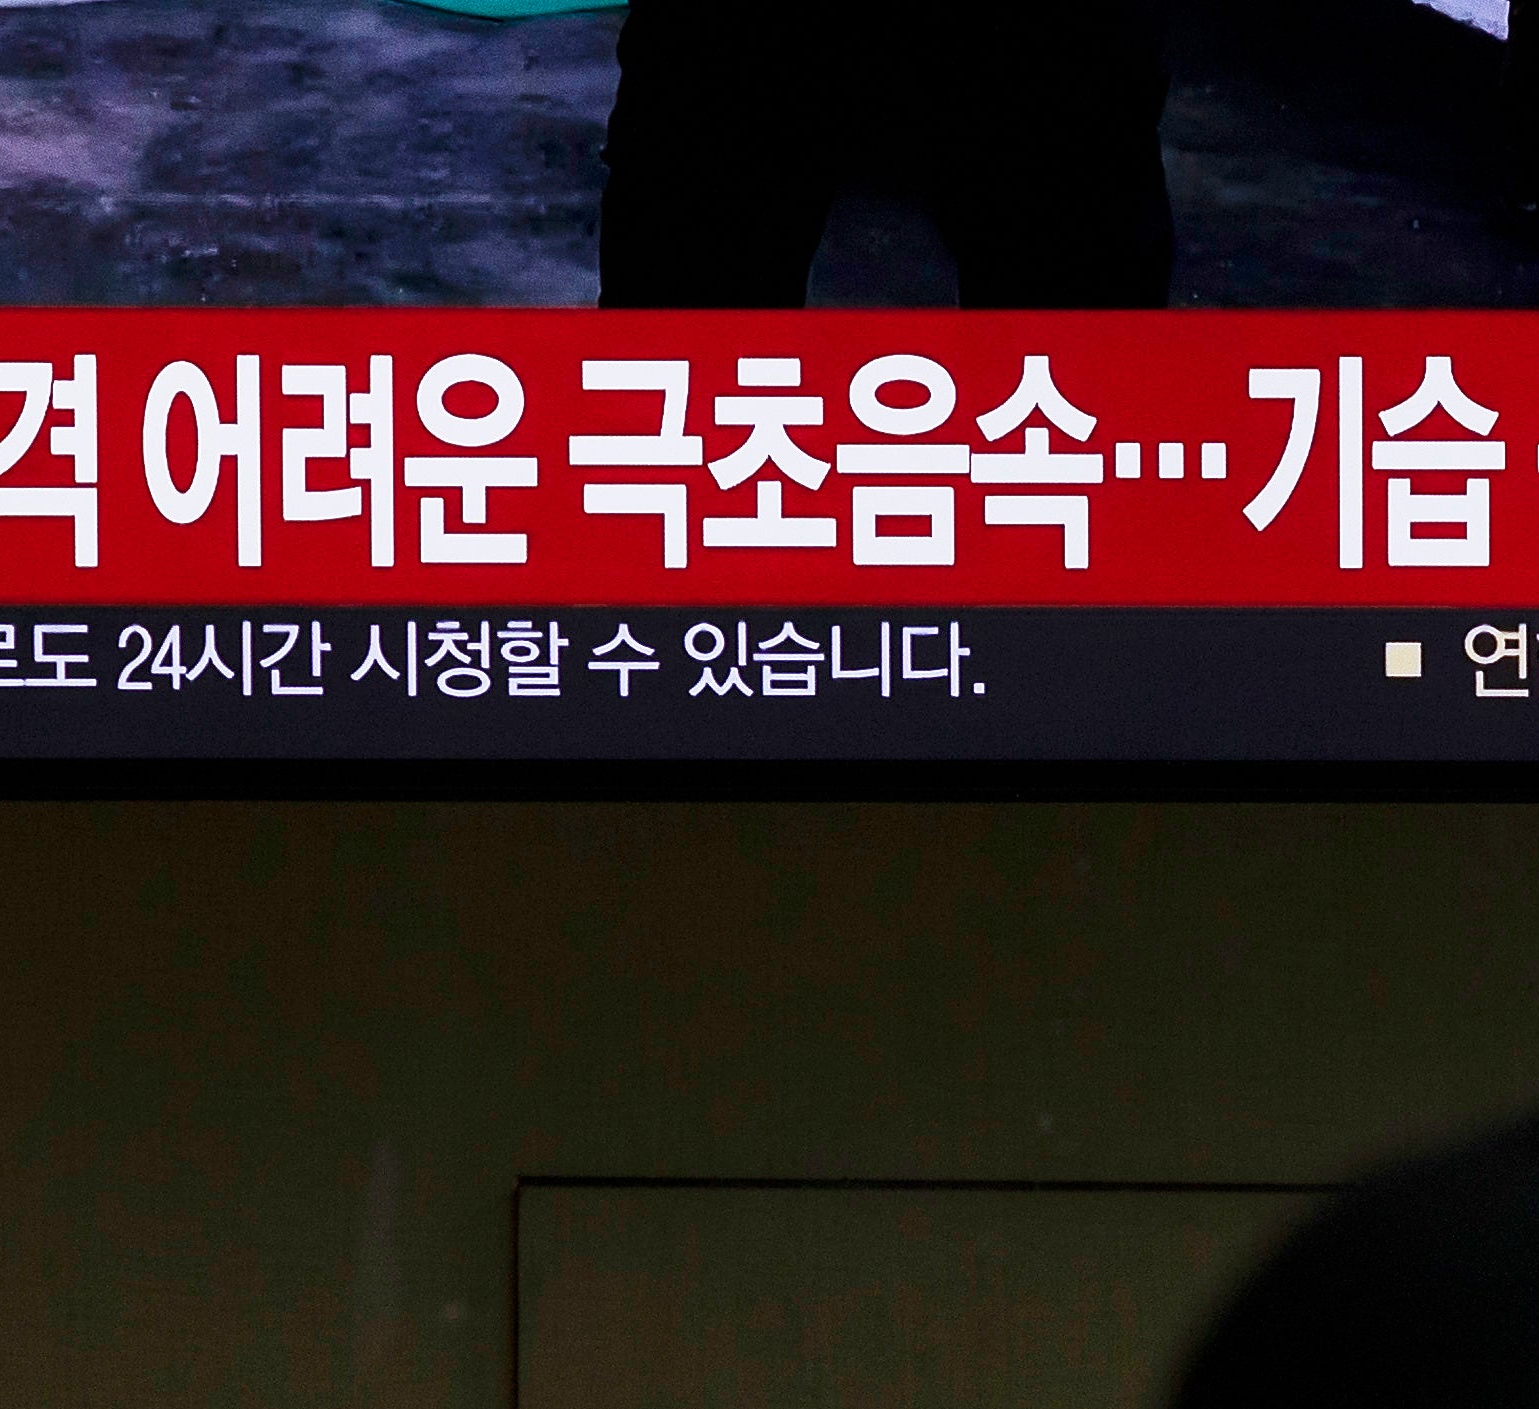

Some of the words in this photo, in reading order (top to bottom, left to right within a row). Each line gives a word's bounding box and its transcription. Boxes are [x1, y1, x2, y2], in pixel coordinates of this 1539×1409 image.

[143, 353, 537, 567] 어려운
[117, 620, 332, 696] 24시간
[350, 620, 570, 698] 시청할
[587, 623, 660, 698] 수
[684, 621, 985, 698] 있습니다.
